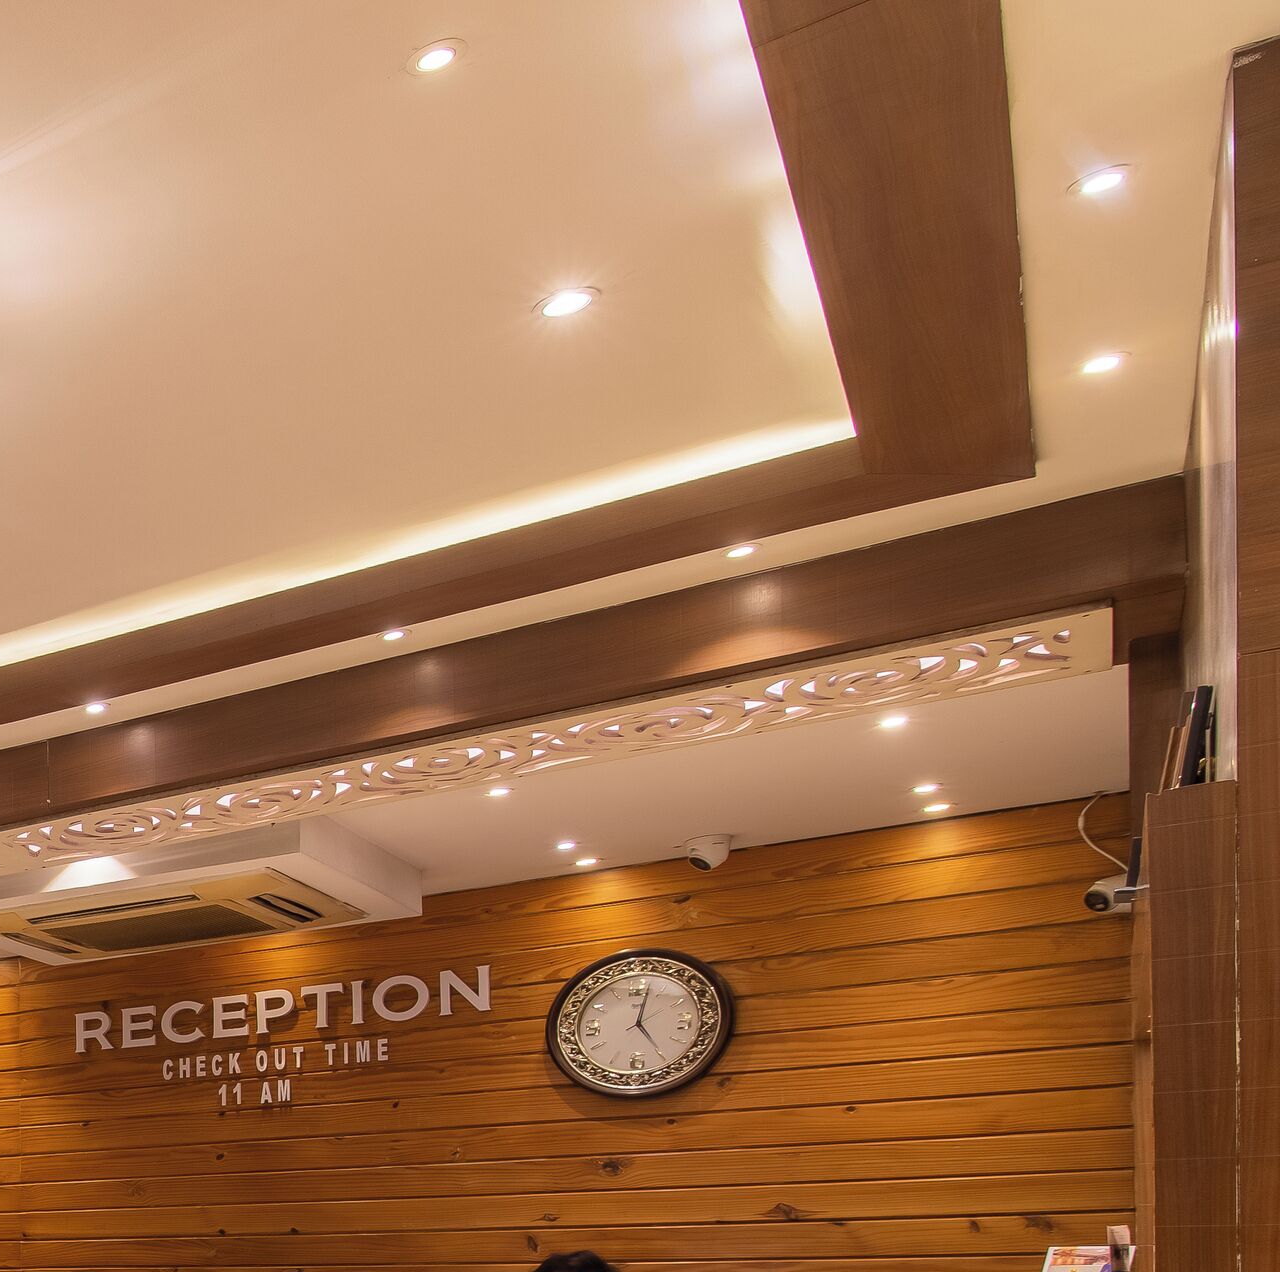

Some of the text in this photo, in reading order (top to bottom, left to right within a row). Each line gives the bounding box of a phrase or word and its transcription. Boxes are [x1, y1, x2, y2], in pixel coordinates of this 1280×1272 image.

[73, 964, 492, 1054] RECEPTION
[162, 1037, 390, 1081] CHECK OUT TIME
[217, 1079, 292, 1107] 11 AM
